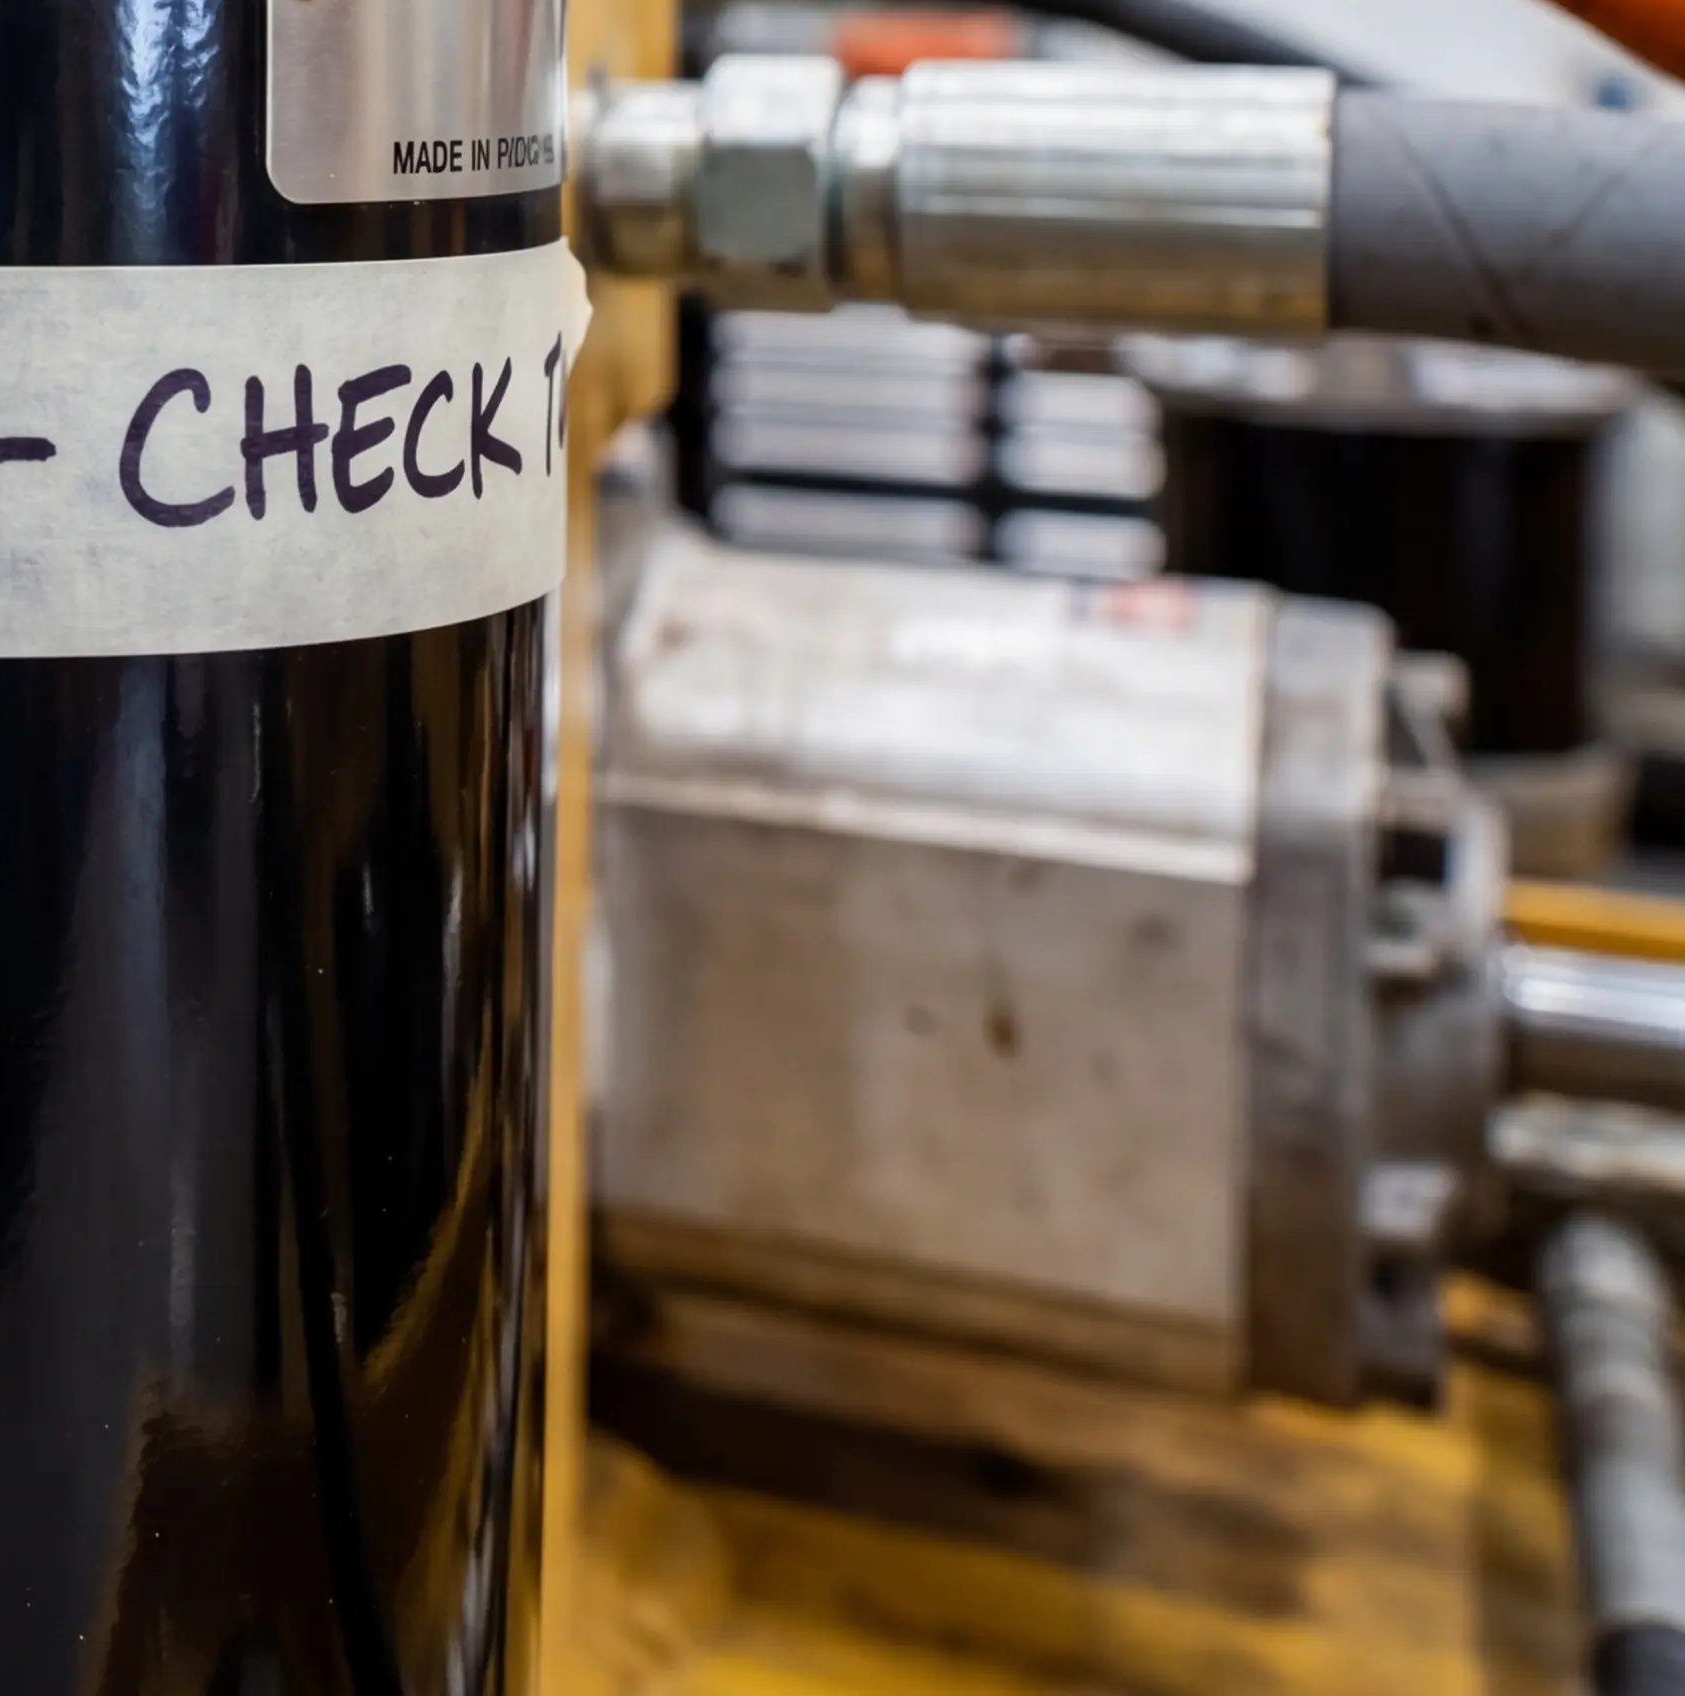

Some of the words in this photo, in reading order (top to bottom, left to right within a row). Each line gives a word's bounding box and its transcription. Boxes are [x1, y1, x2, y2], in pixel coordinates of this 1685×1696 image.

[393, 140, 463, 174] MADE
[471, 138, 491, 171] IN
[118, 356, 523, 528] CHECK
